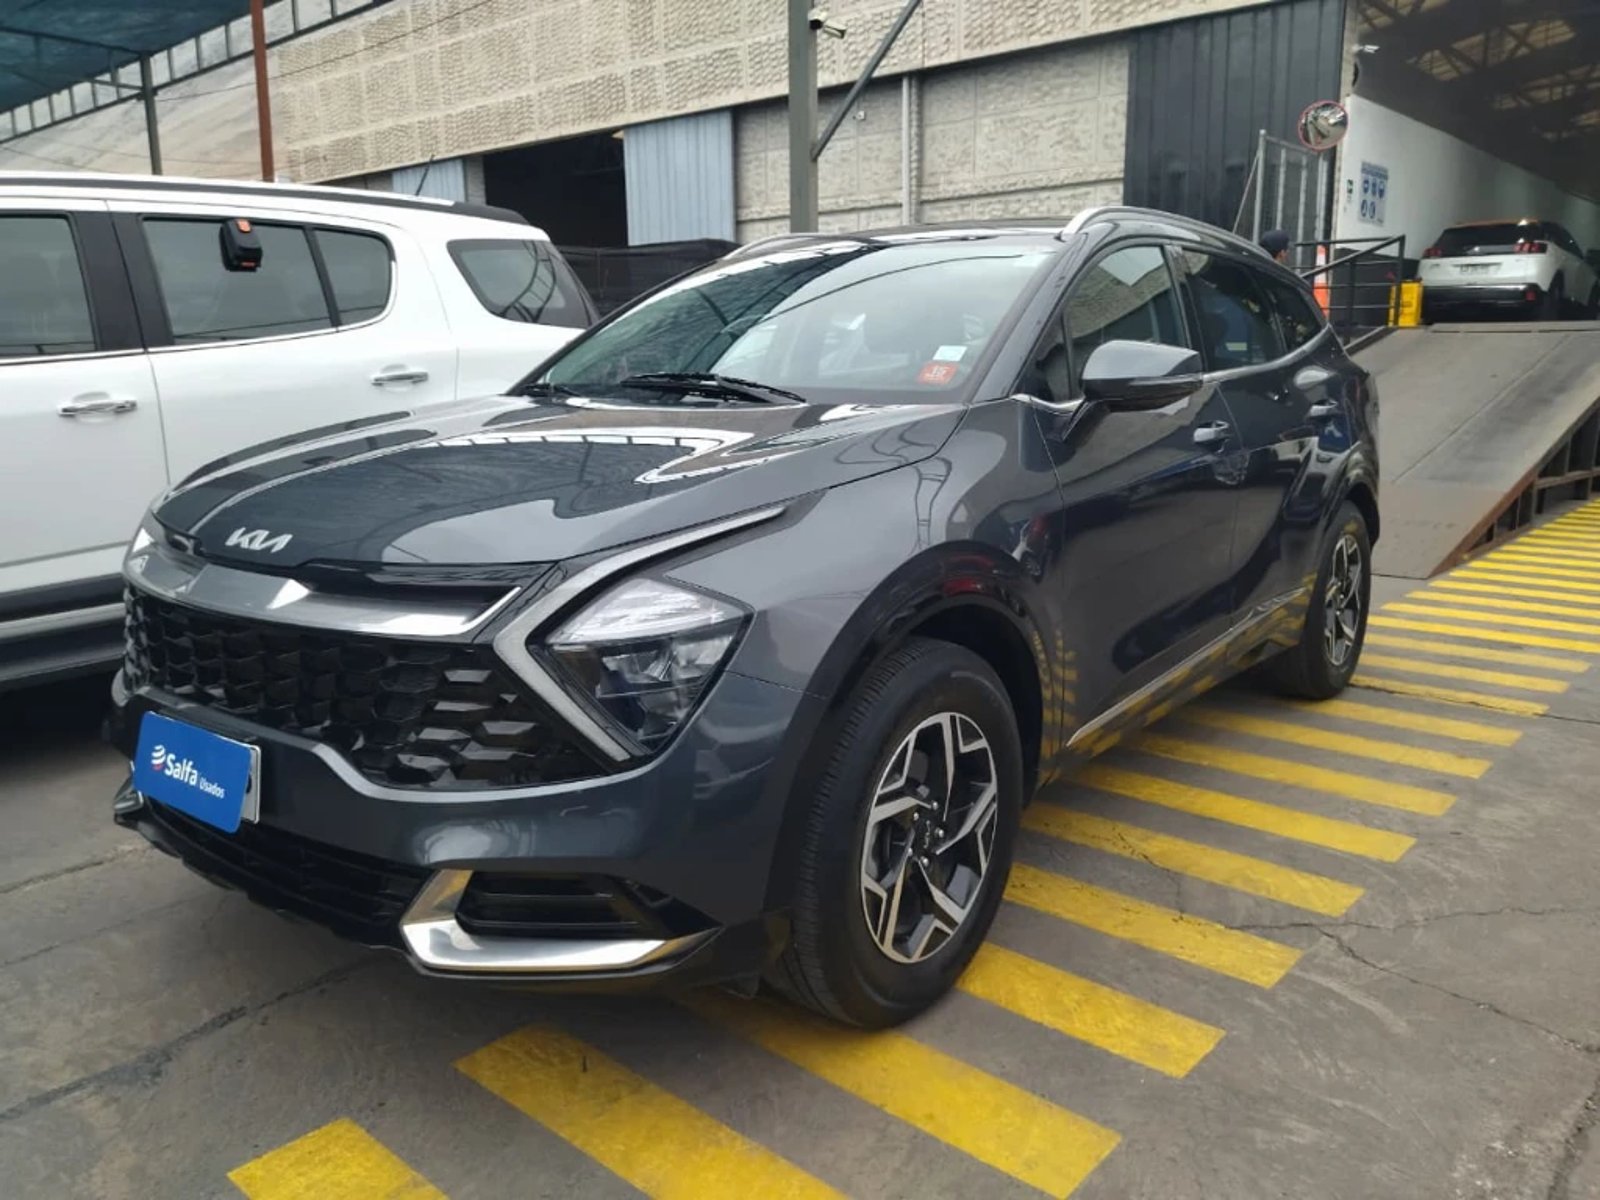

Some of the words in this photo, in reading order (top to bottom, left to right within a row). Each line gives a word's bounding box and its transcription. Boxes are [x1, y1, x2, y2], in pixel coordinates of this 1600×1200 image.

[224, 526, 293, 554] KIA
[164, 752, 198, 787] Salfa
[199, 776, 225, 799] Usados
